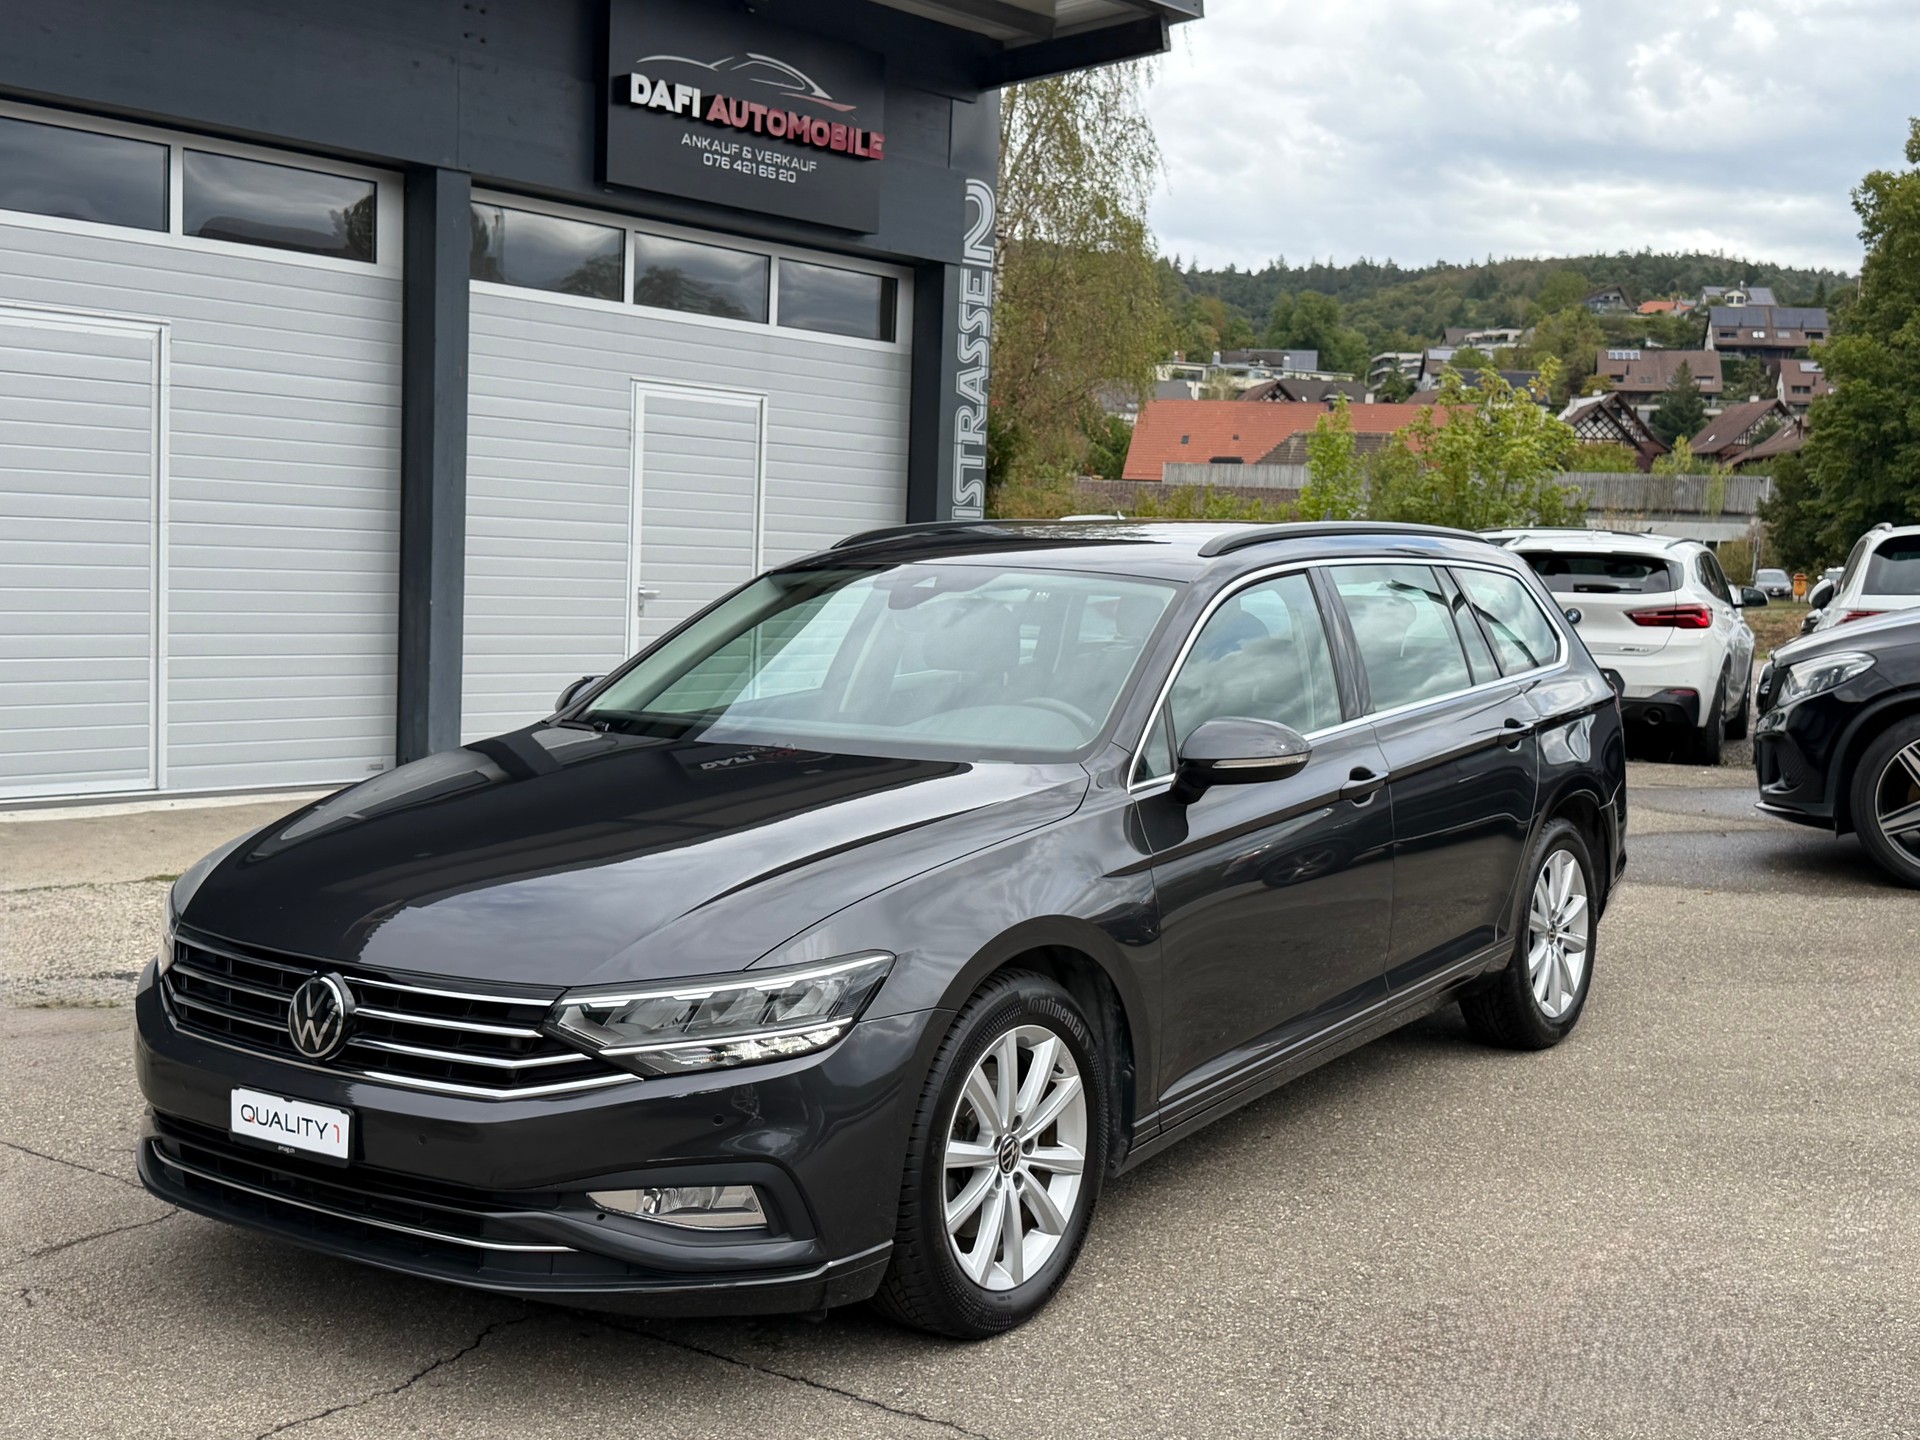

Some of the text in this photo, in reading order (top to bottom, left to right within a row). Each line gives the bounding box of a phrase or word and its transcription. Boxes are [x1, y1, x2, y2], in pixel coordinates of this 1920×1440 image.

[630, 72, 884, 160] DAFI AUTOMOBILE
[681, 133, 817, 173] ANKAUF & VERKAUF
[703, 153, 797, 183] 076 421 65 20
[1028, 995, 1085, 1040] Continental
[240, 1104, 340, 1144] QUALITY 1
